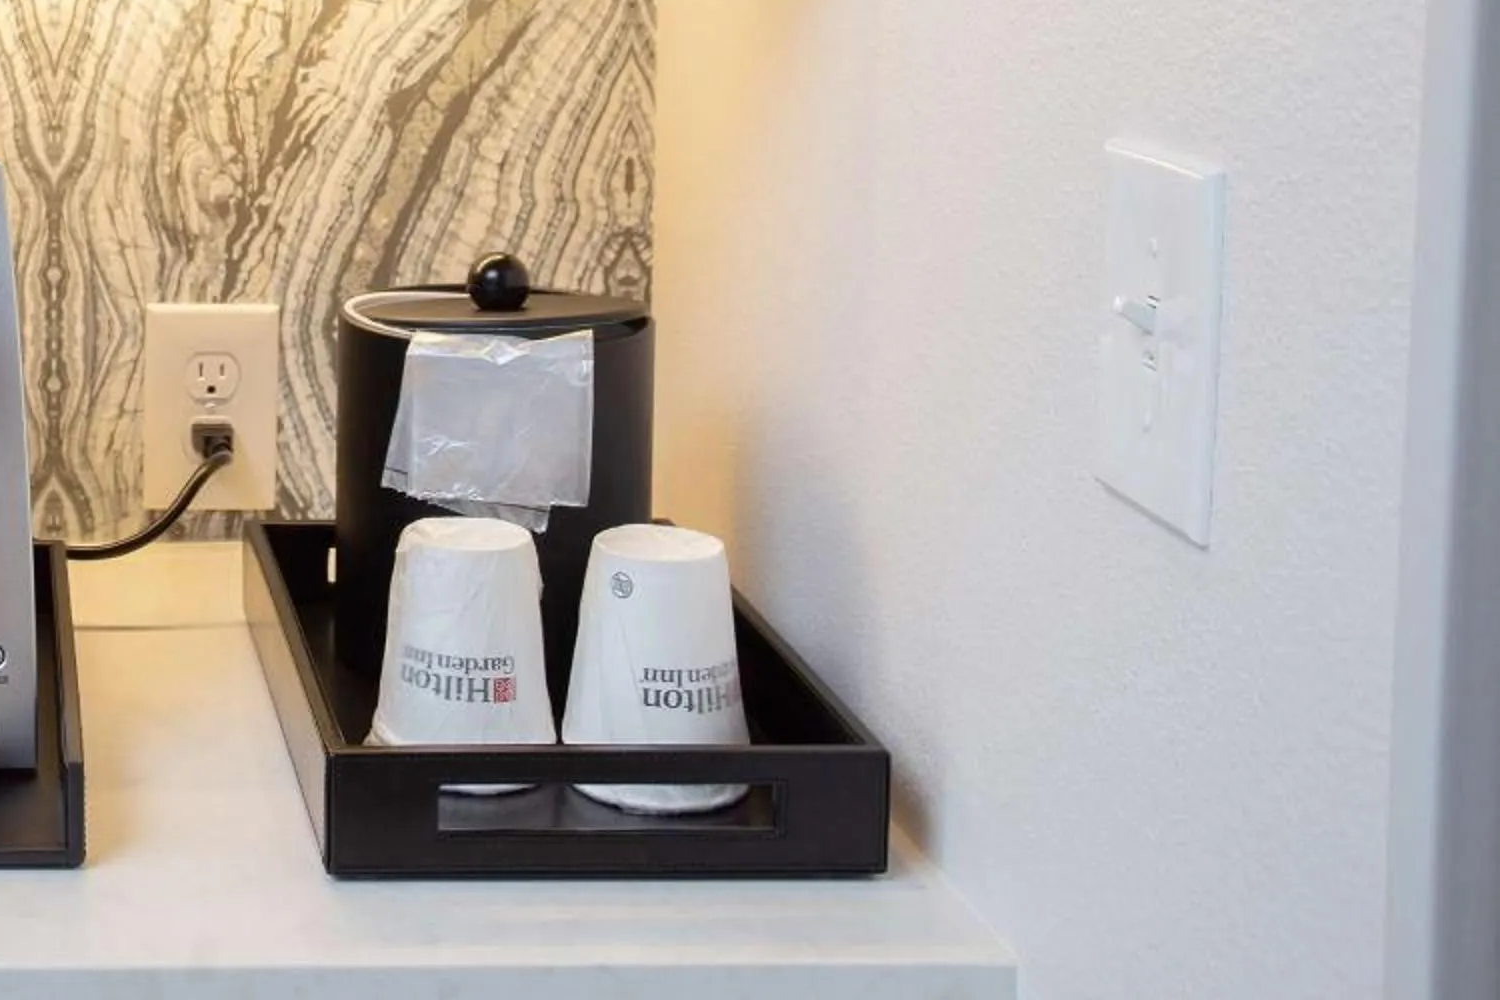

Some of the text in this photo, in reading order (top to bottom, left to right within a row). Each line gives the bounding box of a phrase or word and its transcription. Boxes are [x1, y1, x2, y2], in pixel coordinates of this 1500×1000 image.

[437, 654, 515, 675] Garden
[401, 663, 491, 703] Hilton
[642, 668, 682, 689] Inn
